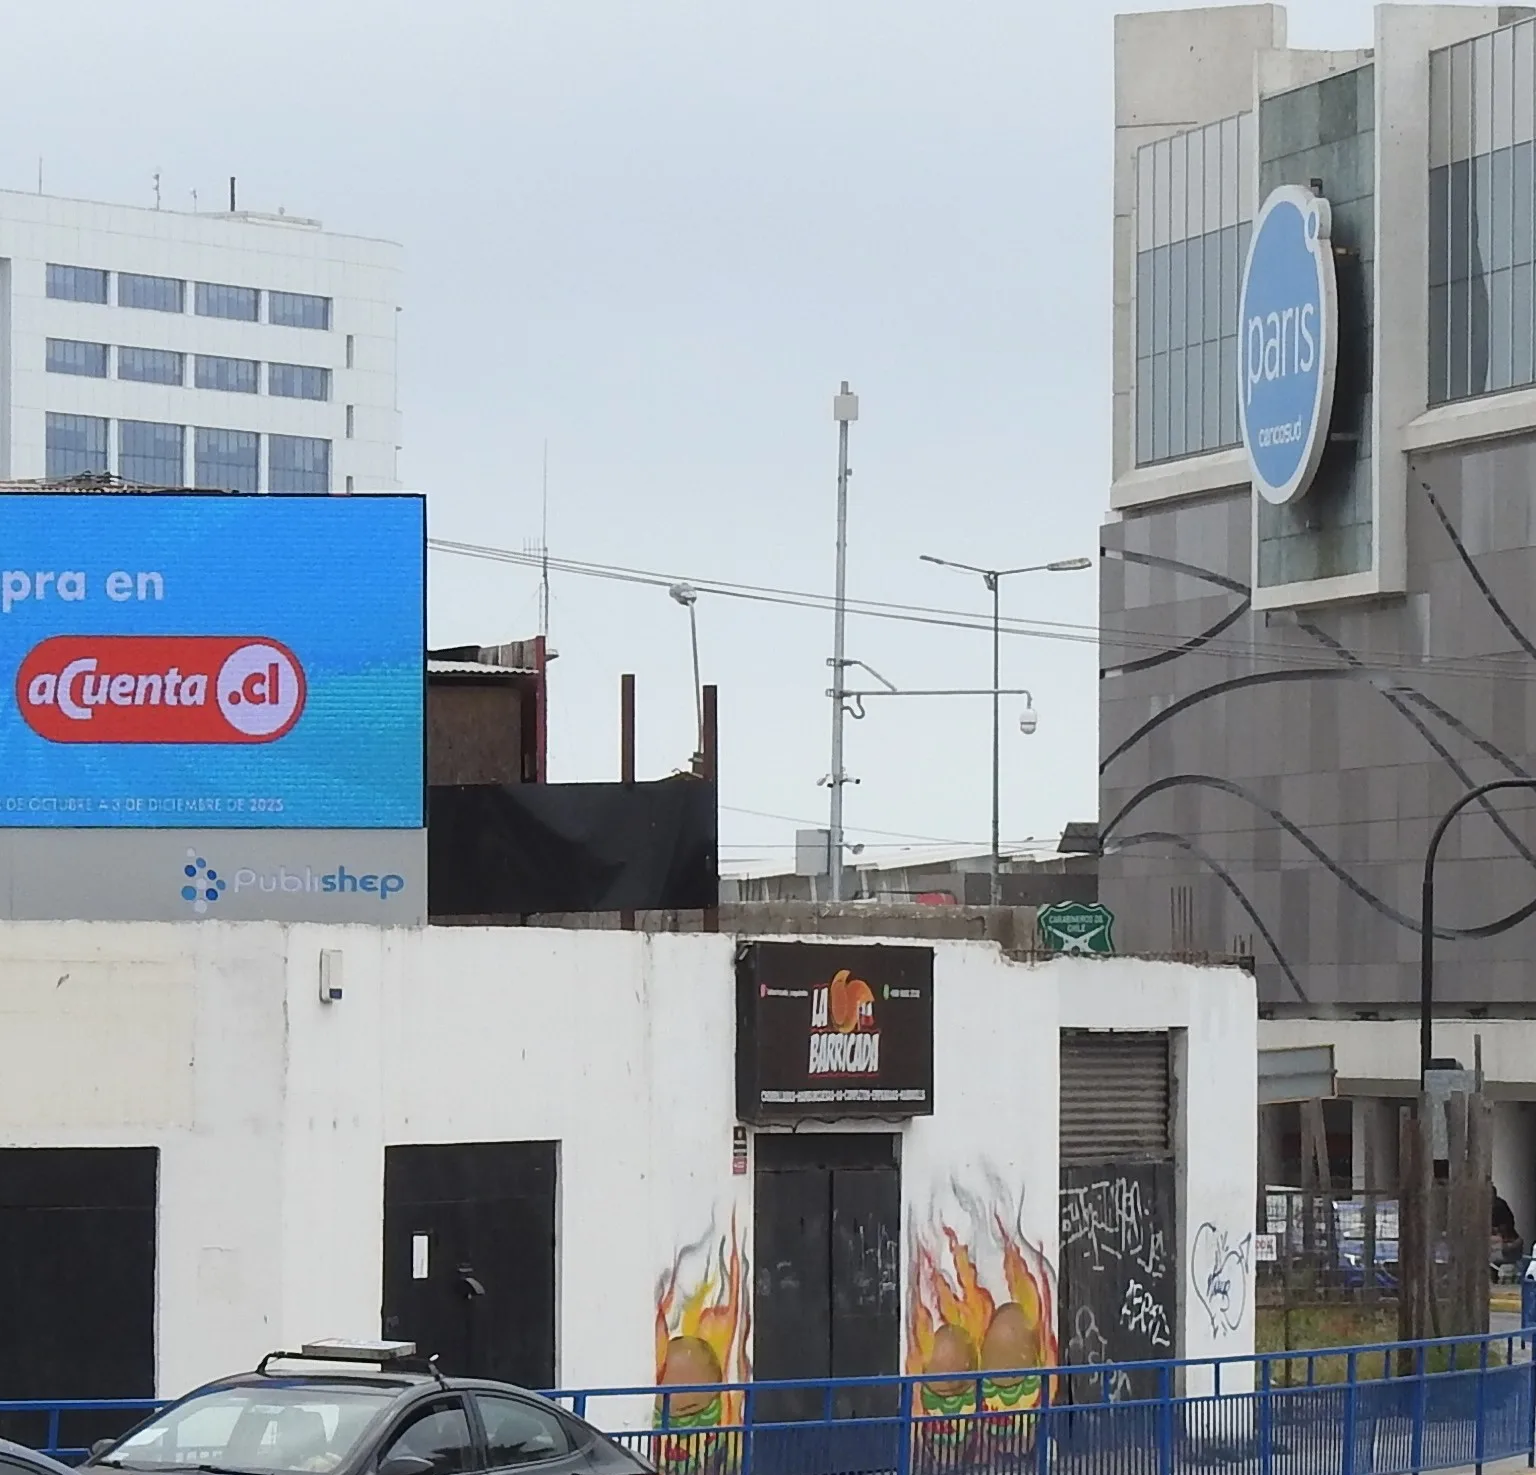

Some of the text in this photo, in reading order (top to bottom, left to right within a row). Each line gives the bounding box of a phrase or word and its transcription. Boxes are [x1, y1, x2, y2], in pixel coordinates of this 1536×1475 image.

[1247, 302, 1314, 407] paris
[106, 570, 164, 601] en
[28, 656, 279, 720] aCuenta .cl
[6, 797, 26, 811] DE
[28, 798, 93, 812] OCTUBRE
[125, 798, 145, 812] DE
[148, 798, 222, 812] DICIEMBRE
[227, 798, 246, 812] DE
[250, 798, 284, 812] 2025
[233, 865, 405, 900] Publishep
[811, 986, 829, 1028] LA
[808, 1032, 880, 1074] BARRICADA
